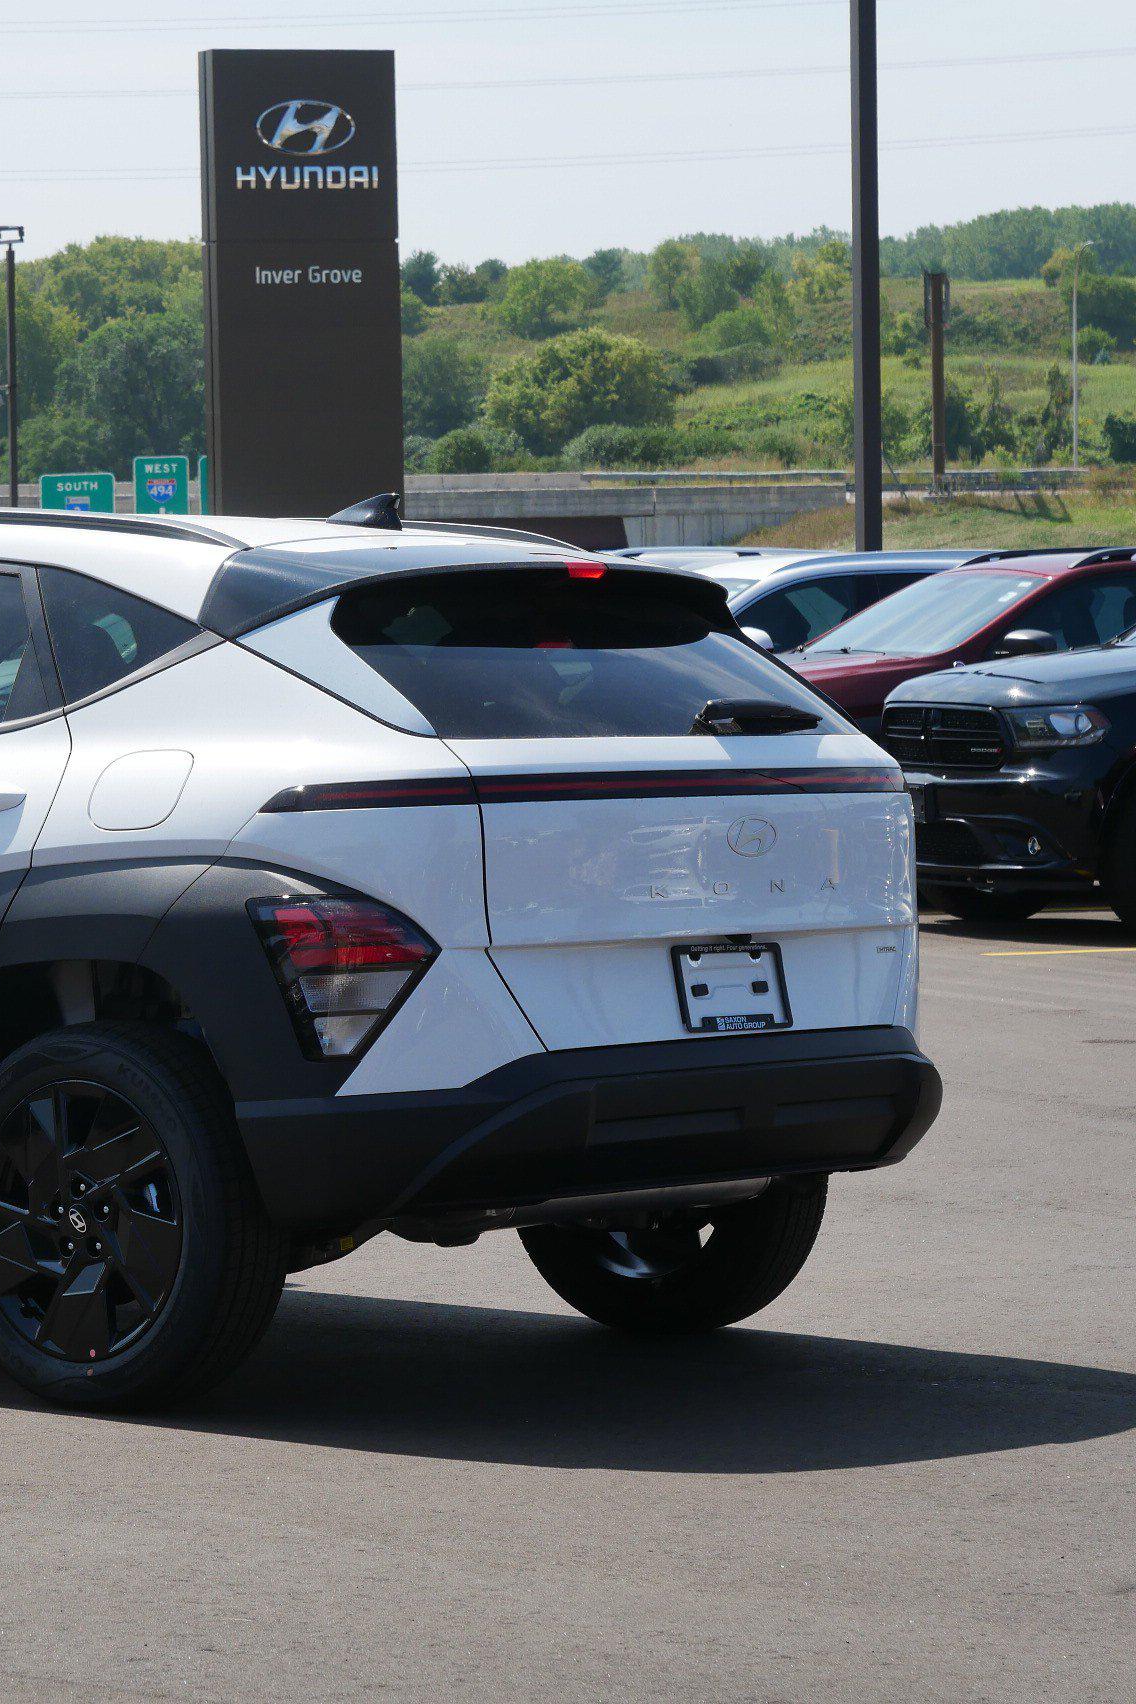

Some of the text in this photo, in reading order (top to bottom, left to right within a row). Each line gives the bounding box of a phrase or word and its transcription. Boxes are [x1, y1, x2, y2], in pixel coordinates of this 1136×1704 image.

[235, 165, 379, 190] HYUNDAI
[255, 265, 363, 284] Inver Grove
[144, 463, 179, 474] WEST
[56, 481, 99, 492] SOUTH
[149, 485, 174, 497] 494
[649, 877, 837, 899] KONA
[726, 1021, 766, 1030] AUTO GROUP
